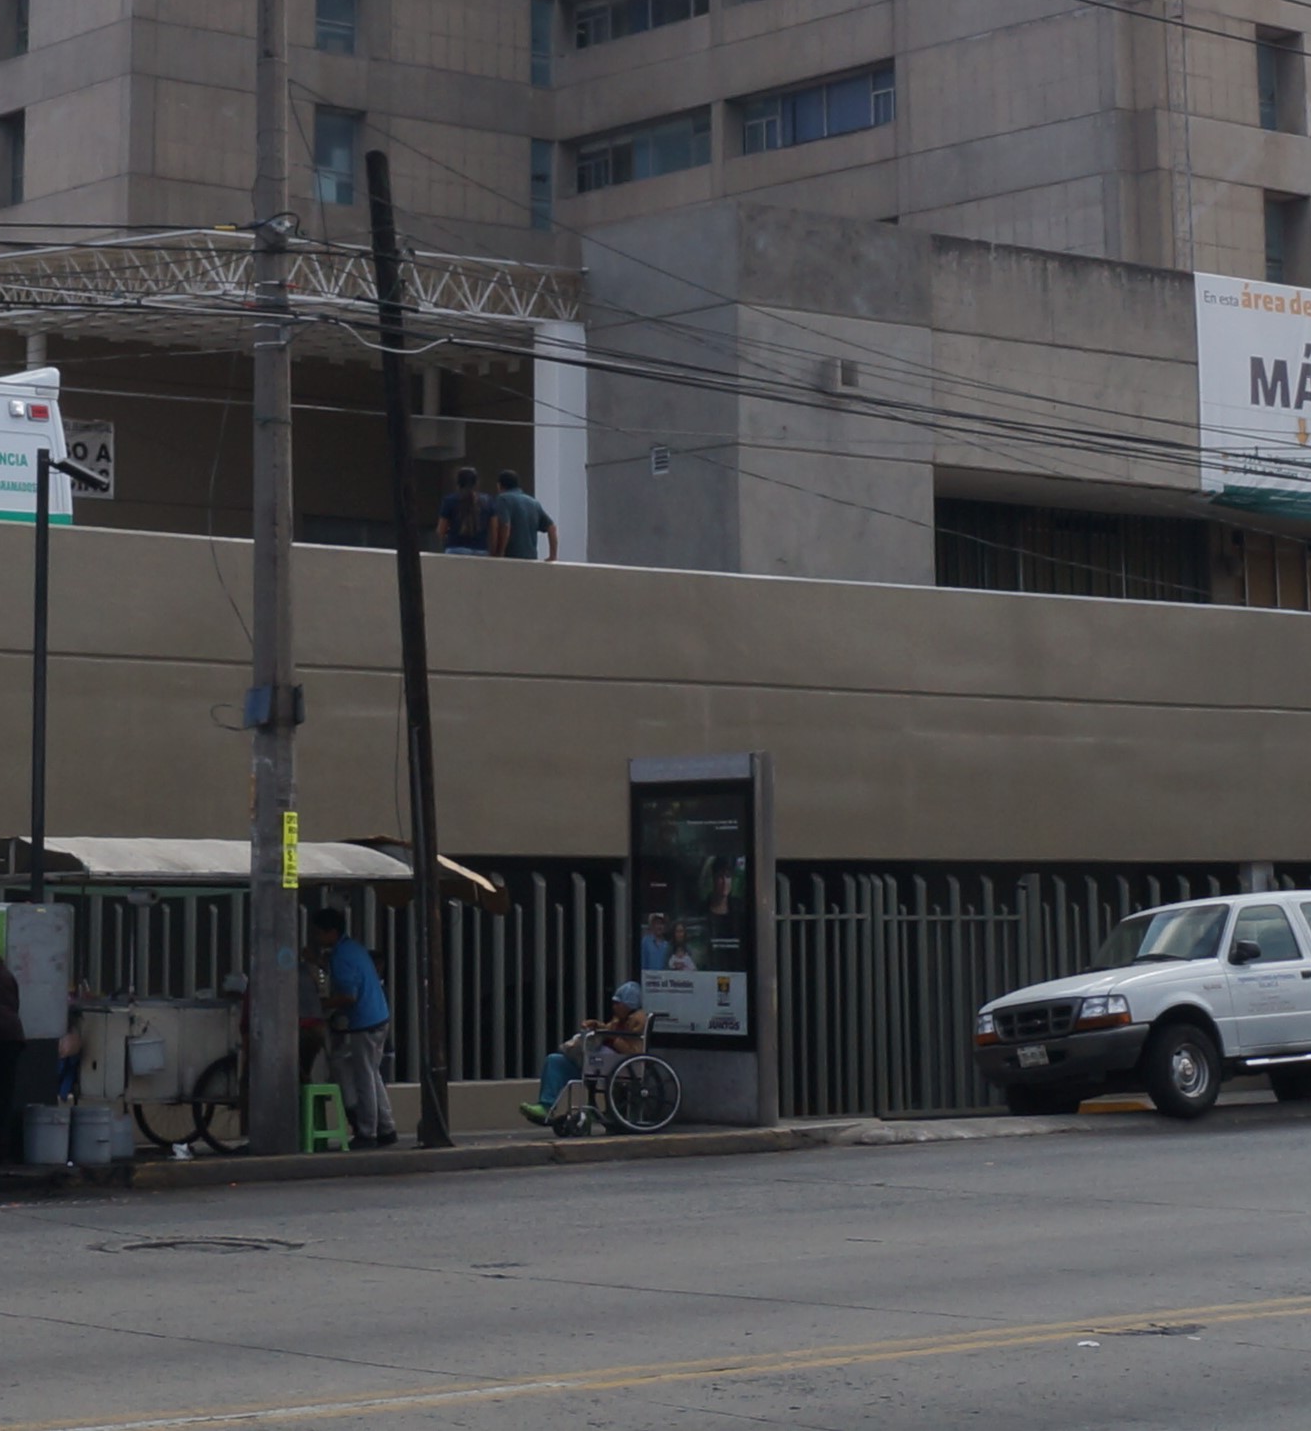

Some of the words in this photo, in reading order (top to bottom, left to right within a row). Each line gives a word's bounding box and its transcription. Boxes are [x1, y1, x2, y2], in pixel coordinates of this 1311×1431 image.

[1203, 290, 1217, 303] En
[1219, 295, 1239, 307] esta
[1241, 283, 1285, 313] área
[96, 442, 112, 463] A
